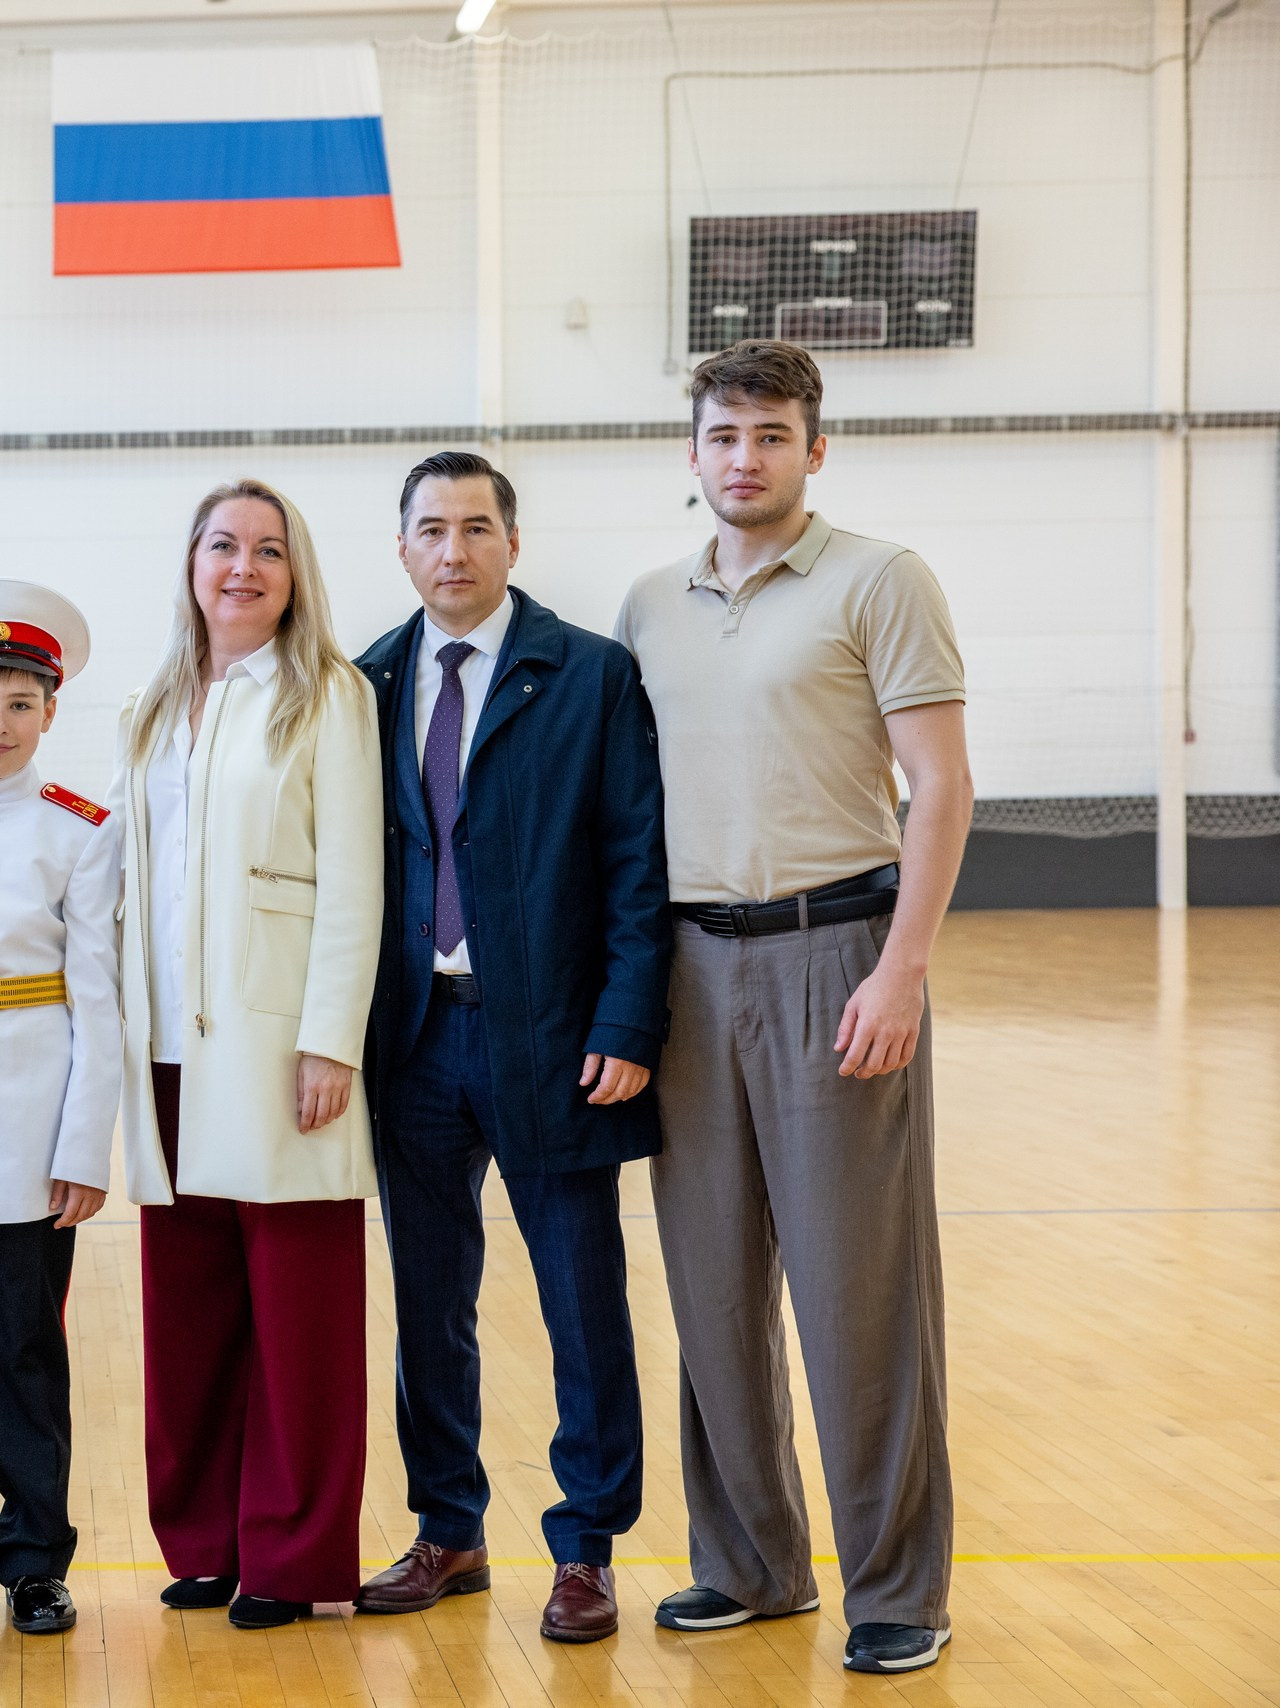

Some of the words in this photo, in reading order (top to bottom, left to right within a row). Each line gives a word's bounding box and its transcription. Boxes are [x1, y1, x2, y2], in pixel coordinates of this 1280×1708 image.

[810, 240, 857, 253] ПЕРИОД
[713, 304, 749, 317] ФОЛЫ
[914, 300, 952, 313] ФОЛЫ
